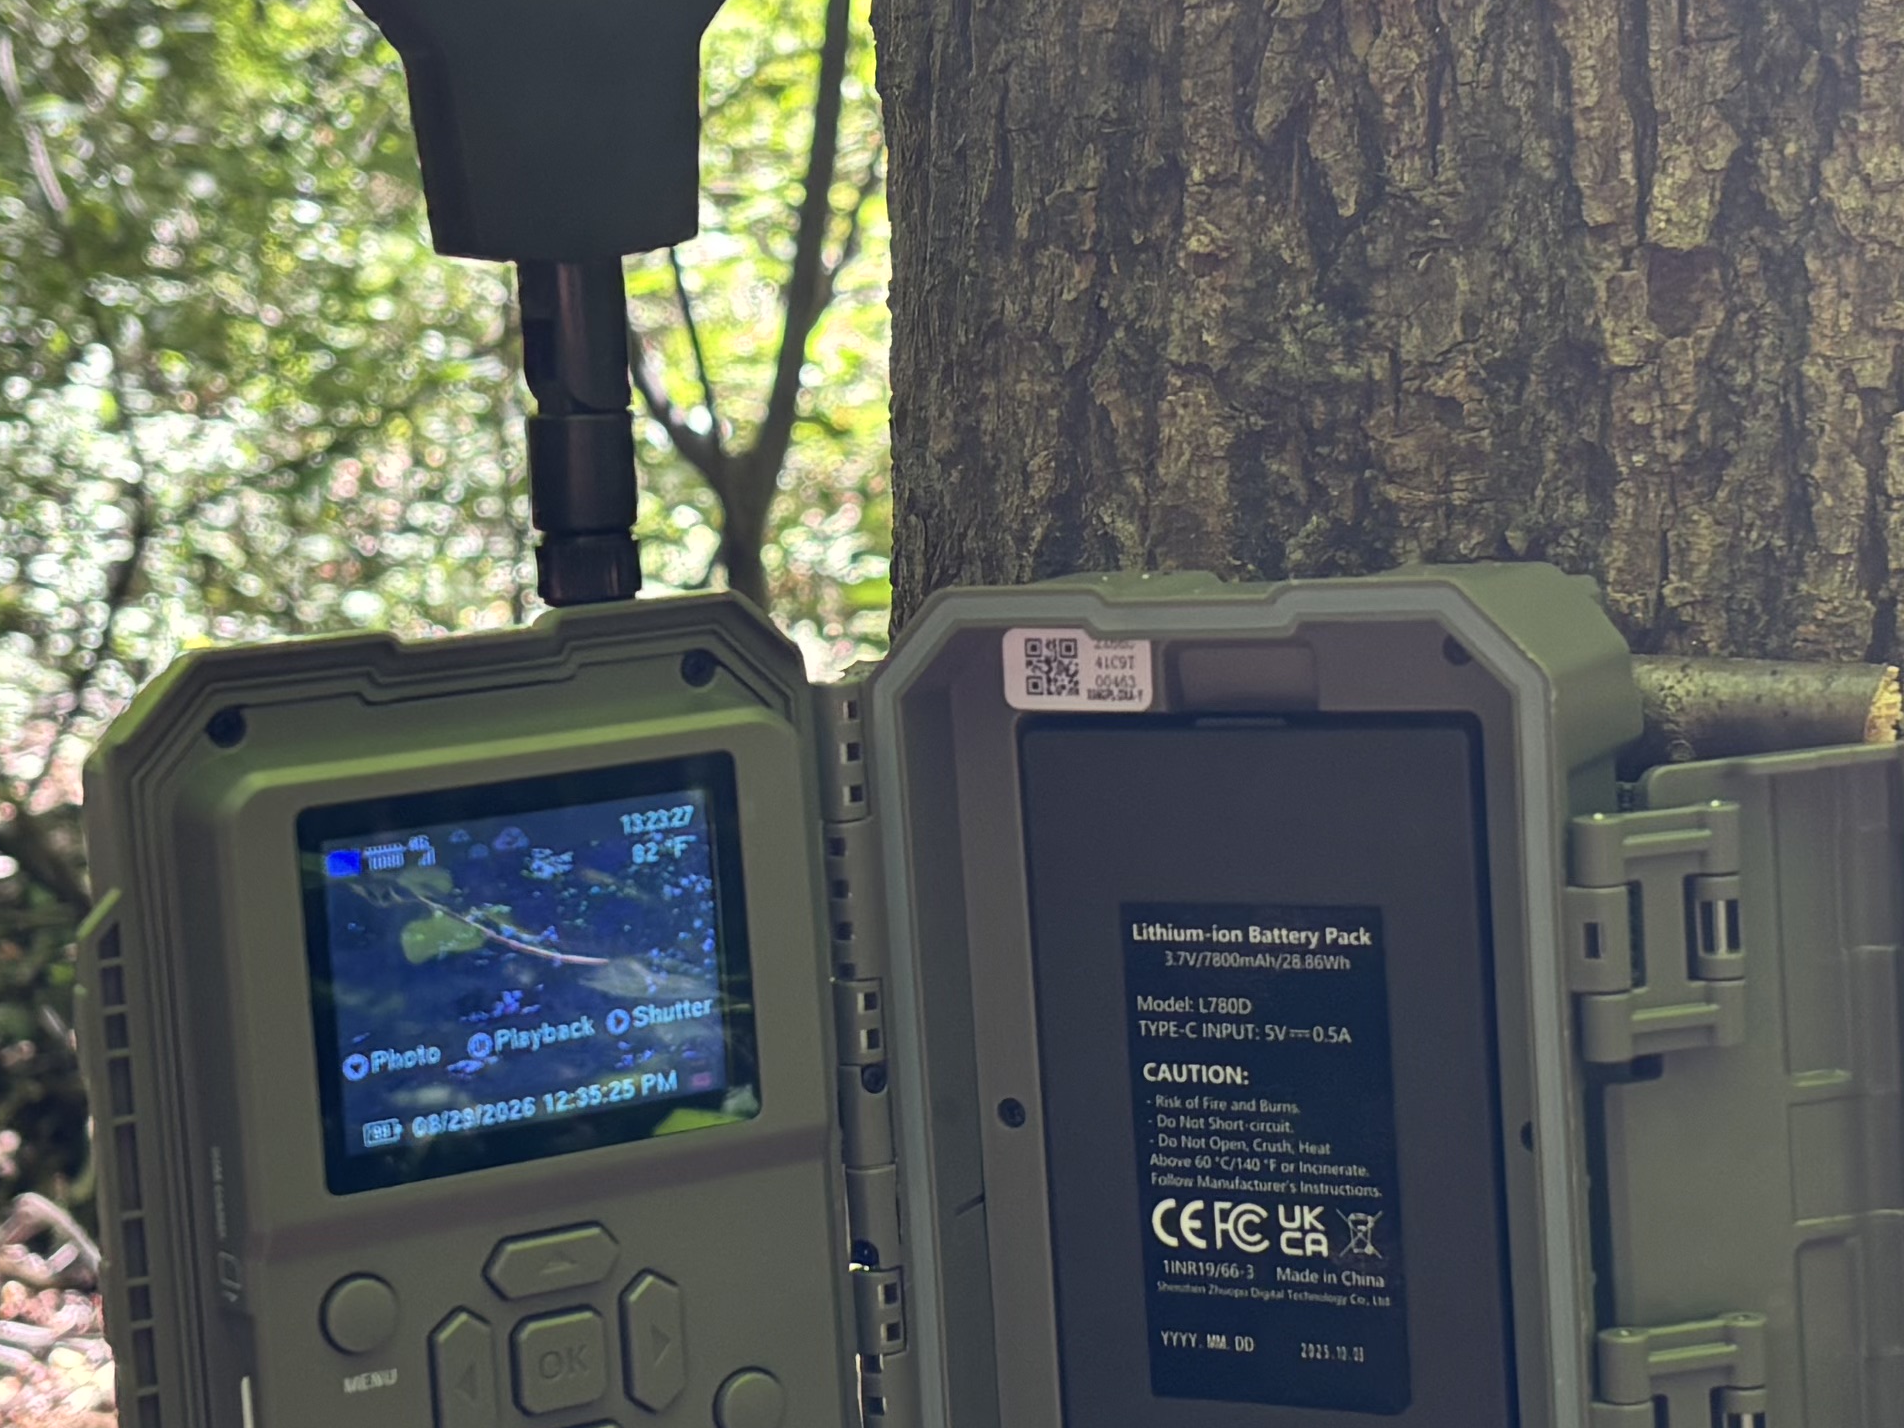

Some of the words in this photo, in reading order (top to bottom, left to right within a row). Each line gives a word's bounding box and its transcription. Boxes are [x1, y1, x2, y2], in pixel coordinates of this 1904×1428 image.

[1132, 923, 1243, 944] Lithium-ion
[1248, 925, 1319, 949] Battery
[1325, 926, 1373, 946] Pack
[632, 996, 713, 1030] Shutter
[1137, 995, 1194, 1013] Model:
[1198, 997, 1253, 1015] L780D
[495, 1016, 595, 1052] Playback
[1139, 1020, 1198, 1039] TYPE-C
[1202, 1023, 1261, 1041] INPUT:
[370, 1044, 442, 1075] Photo
[1143, 1062, 1250, 1086] CAUTION:
[543, 1079, 636, 1115] 12:35:25
[640, 1070, 679, 1099] PM
[1155, 1095, 1182, 1109] Risk
[1185, 1096, 1199, 1110] of
[1203, 1096, 1227, 1111] Fire
[1231, 1097, 1256, 1113] and
[1157, 1114, 1176, 1130] Do
[1179, 1115, 1205, 1131] Not
[1158, 1134, 1177, 1148] Do
[1181, 1135, 1206, 1149] Not
[1209, 1136, 1250, 1153] Open,
[1253, 1138, 1295, 1155] Crush,
[1299, 1140, 1331, 1155] Heat
[1150, 1152, 1192, 1169] Above
[1281, 1161, 1296, 1174] or
[1151, 1172, 1194, 1188] Follow
[1197, 1174, 1297, 1194] Manufacturer's
[1151, 1197, 1207, 1250] CE
[1278, 1204, 1325, 1231] UK
[1280, 1230, 1329, 1258] CA
[1276, 1266, 1319, 1285] Made
[1323, 1268, 1338, 1286] in
[1341, 1269, 1385, 1289] China
[536, 1344, 589, 1381] OK
[342, 1368, 398, 1394] MENU
